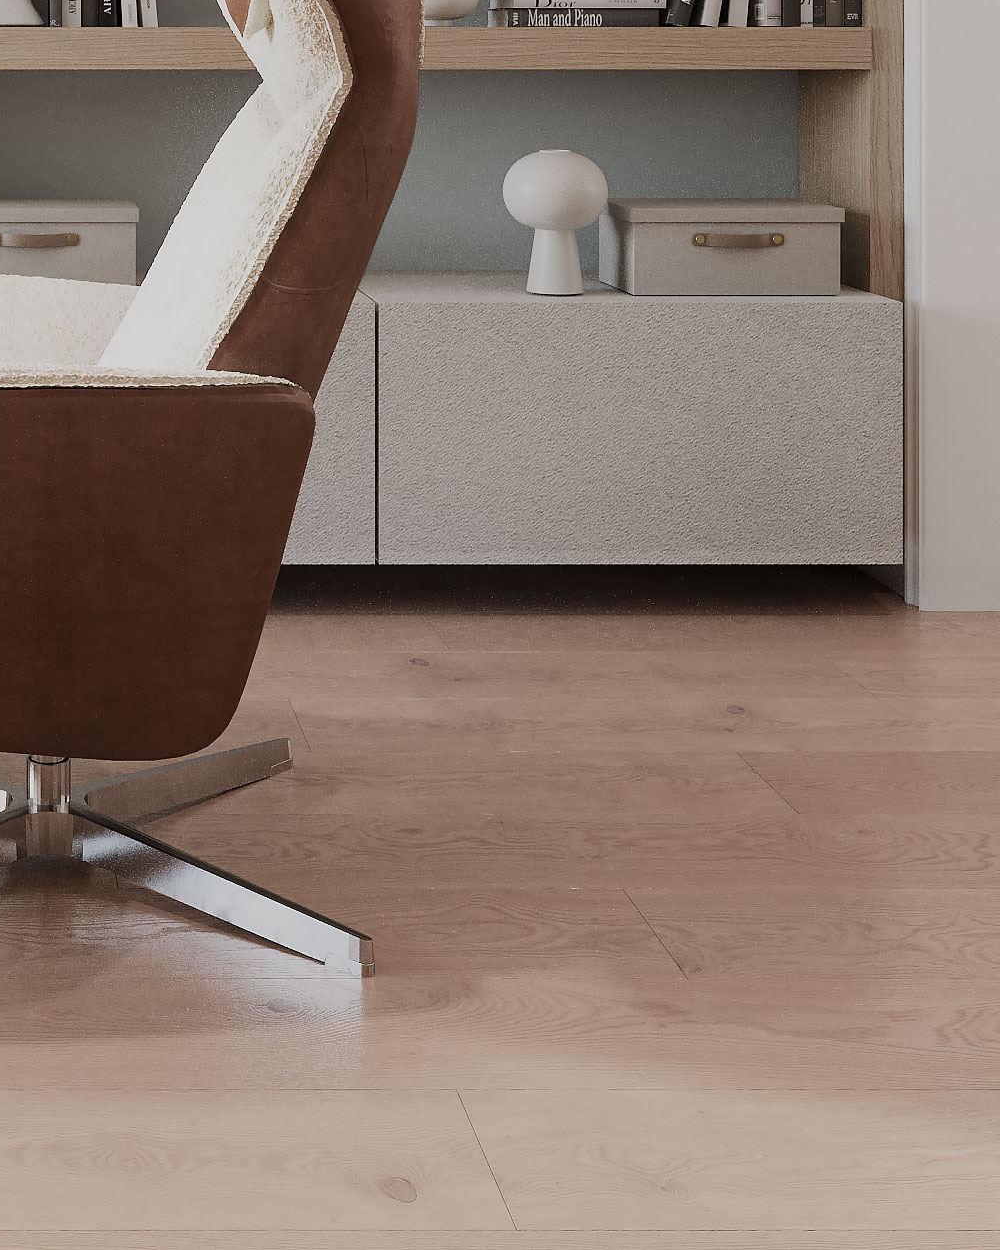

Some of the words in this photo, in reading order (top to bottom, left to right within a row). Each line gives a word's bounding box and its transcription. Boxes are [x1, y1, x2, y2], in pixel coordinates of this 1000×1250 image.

[527, 9, 550, 27] Man
[552, 9, 572, 27] and
[574, 9, 603, 27] Piano
